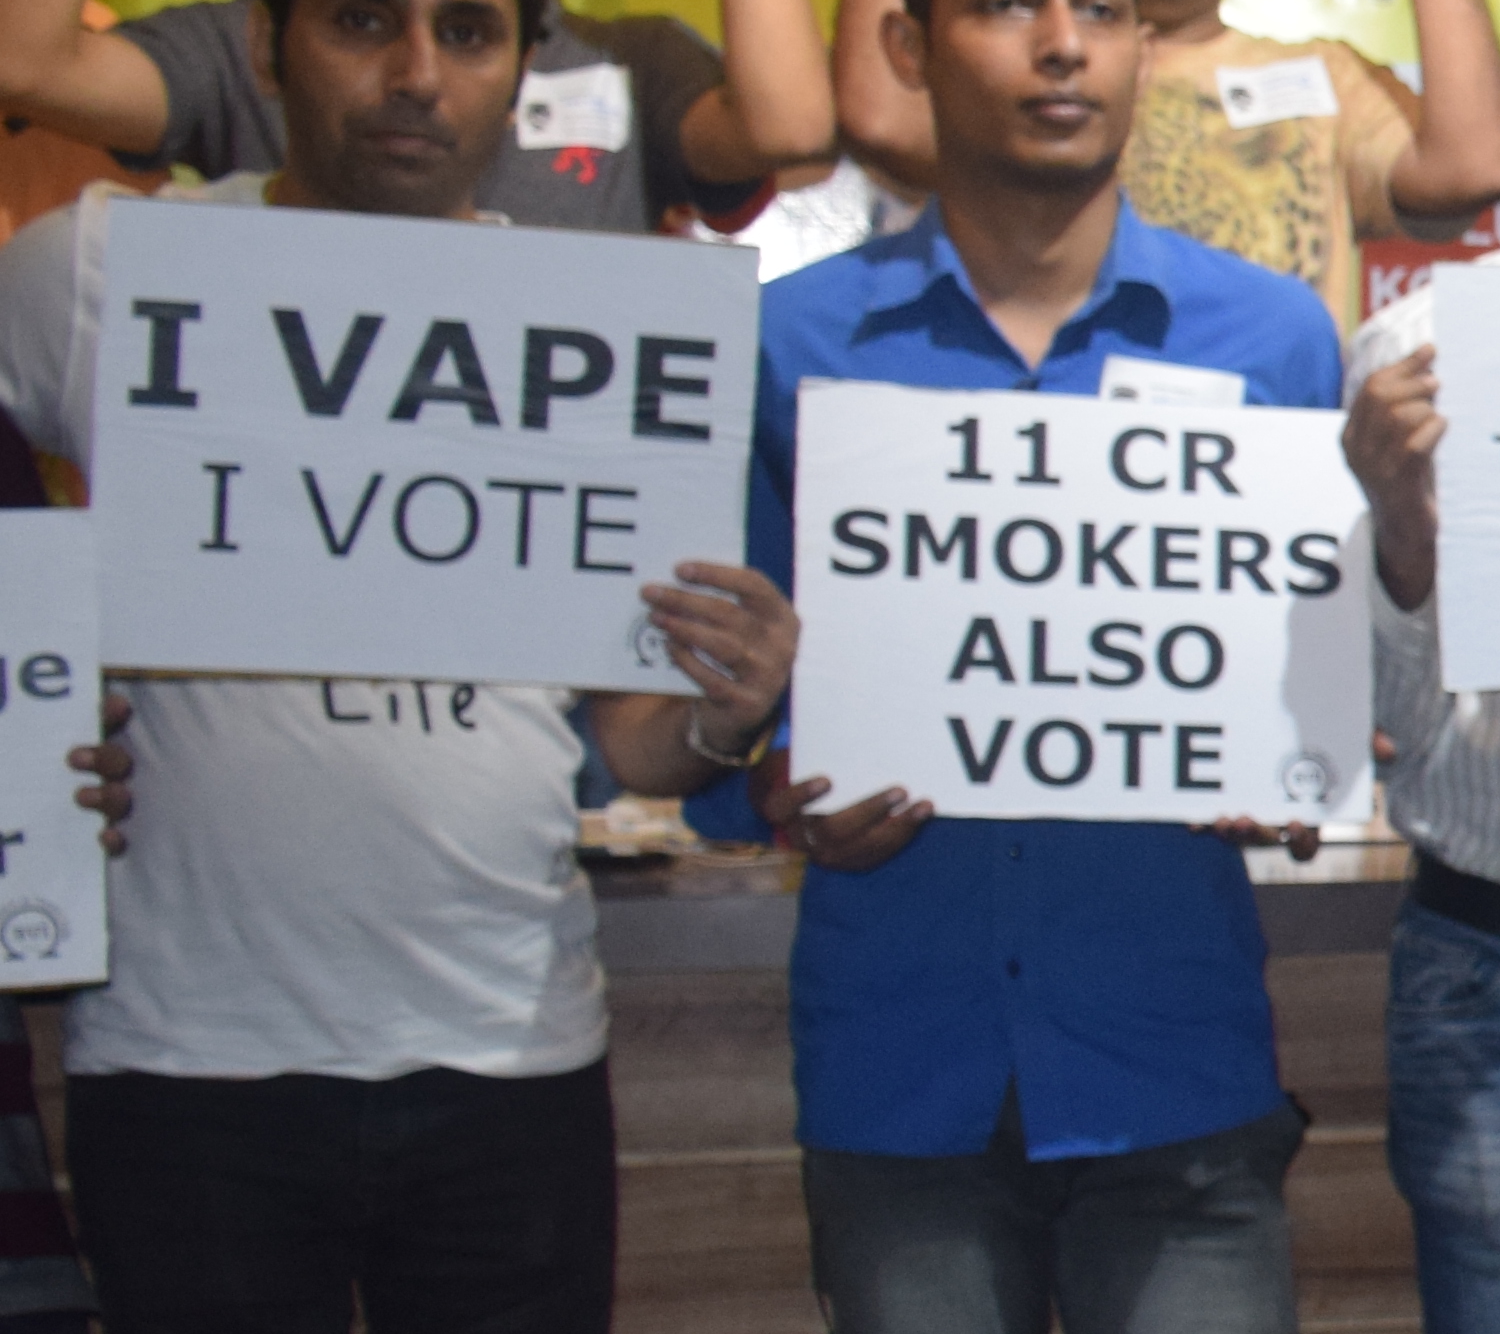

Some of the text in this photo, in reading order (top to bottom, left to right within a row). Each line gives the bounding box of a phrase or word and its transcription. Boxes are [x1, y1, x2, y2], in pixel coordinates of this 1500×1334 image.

[128, 298, 716, 442] I VAPE
[946, 416, 1242, 497] 11 CR
[200, 464, 639, 575] I VOTE
[829, 509, 1342, 598] SMOKERS
[947, 616, 1226, 691] ALSO
[947, 716, 1226, 792] VOTE
